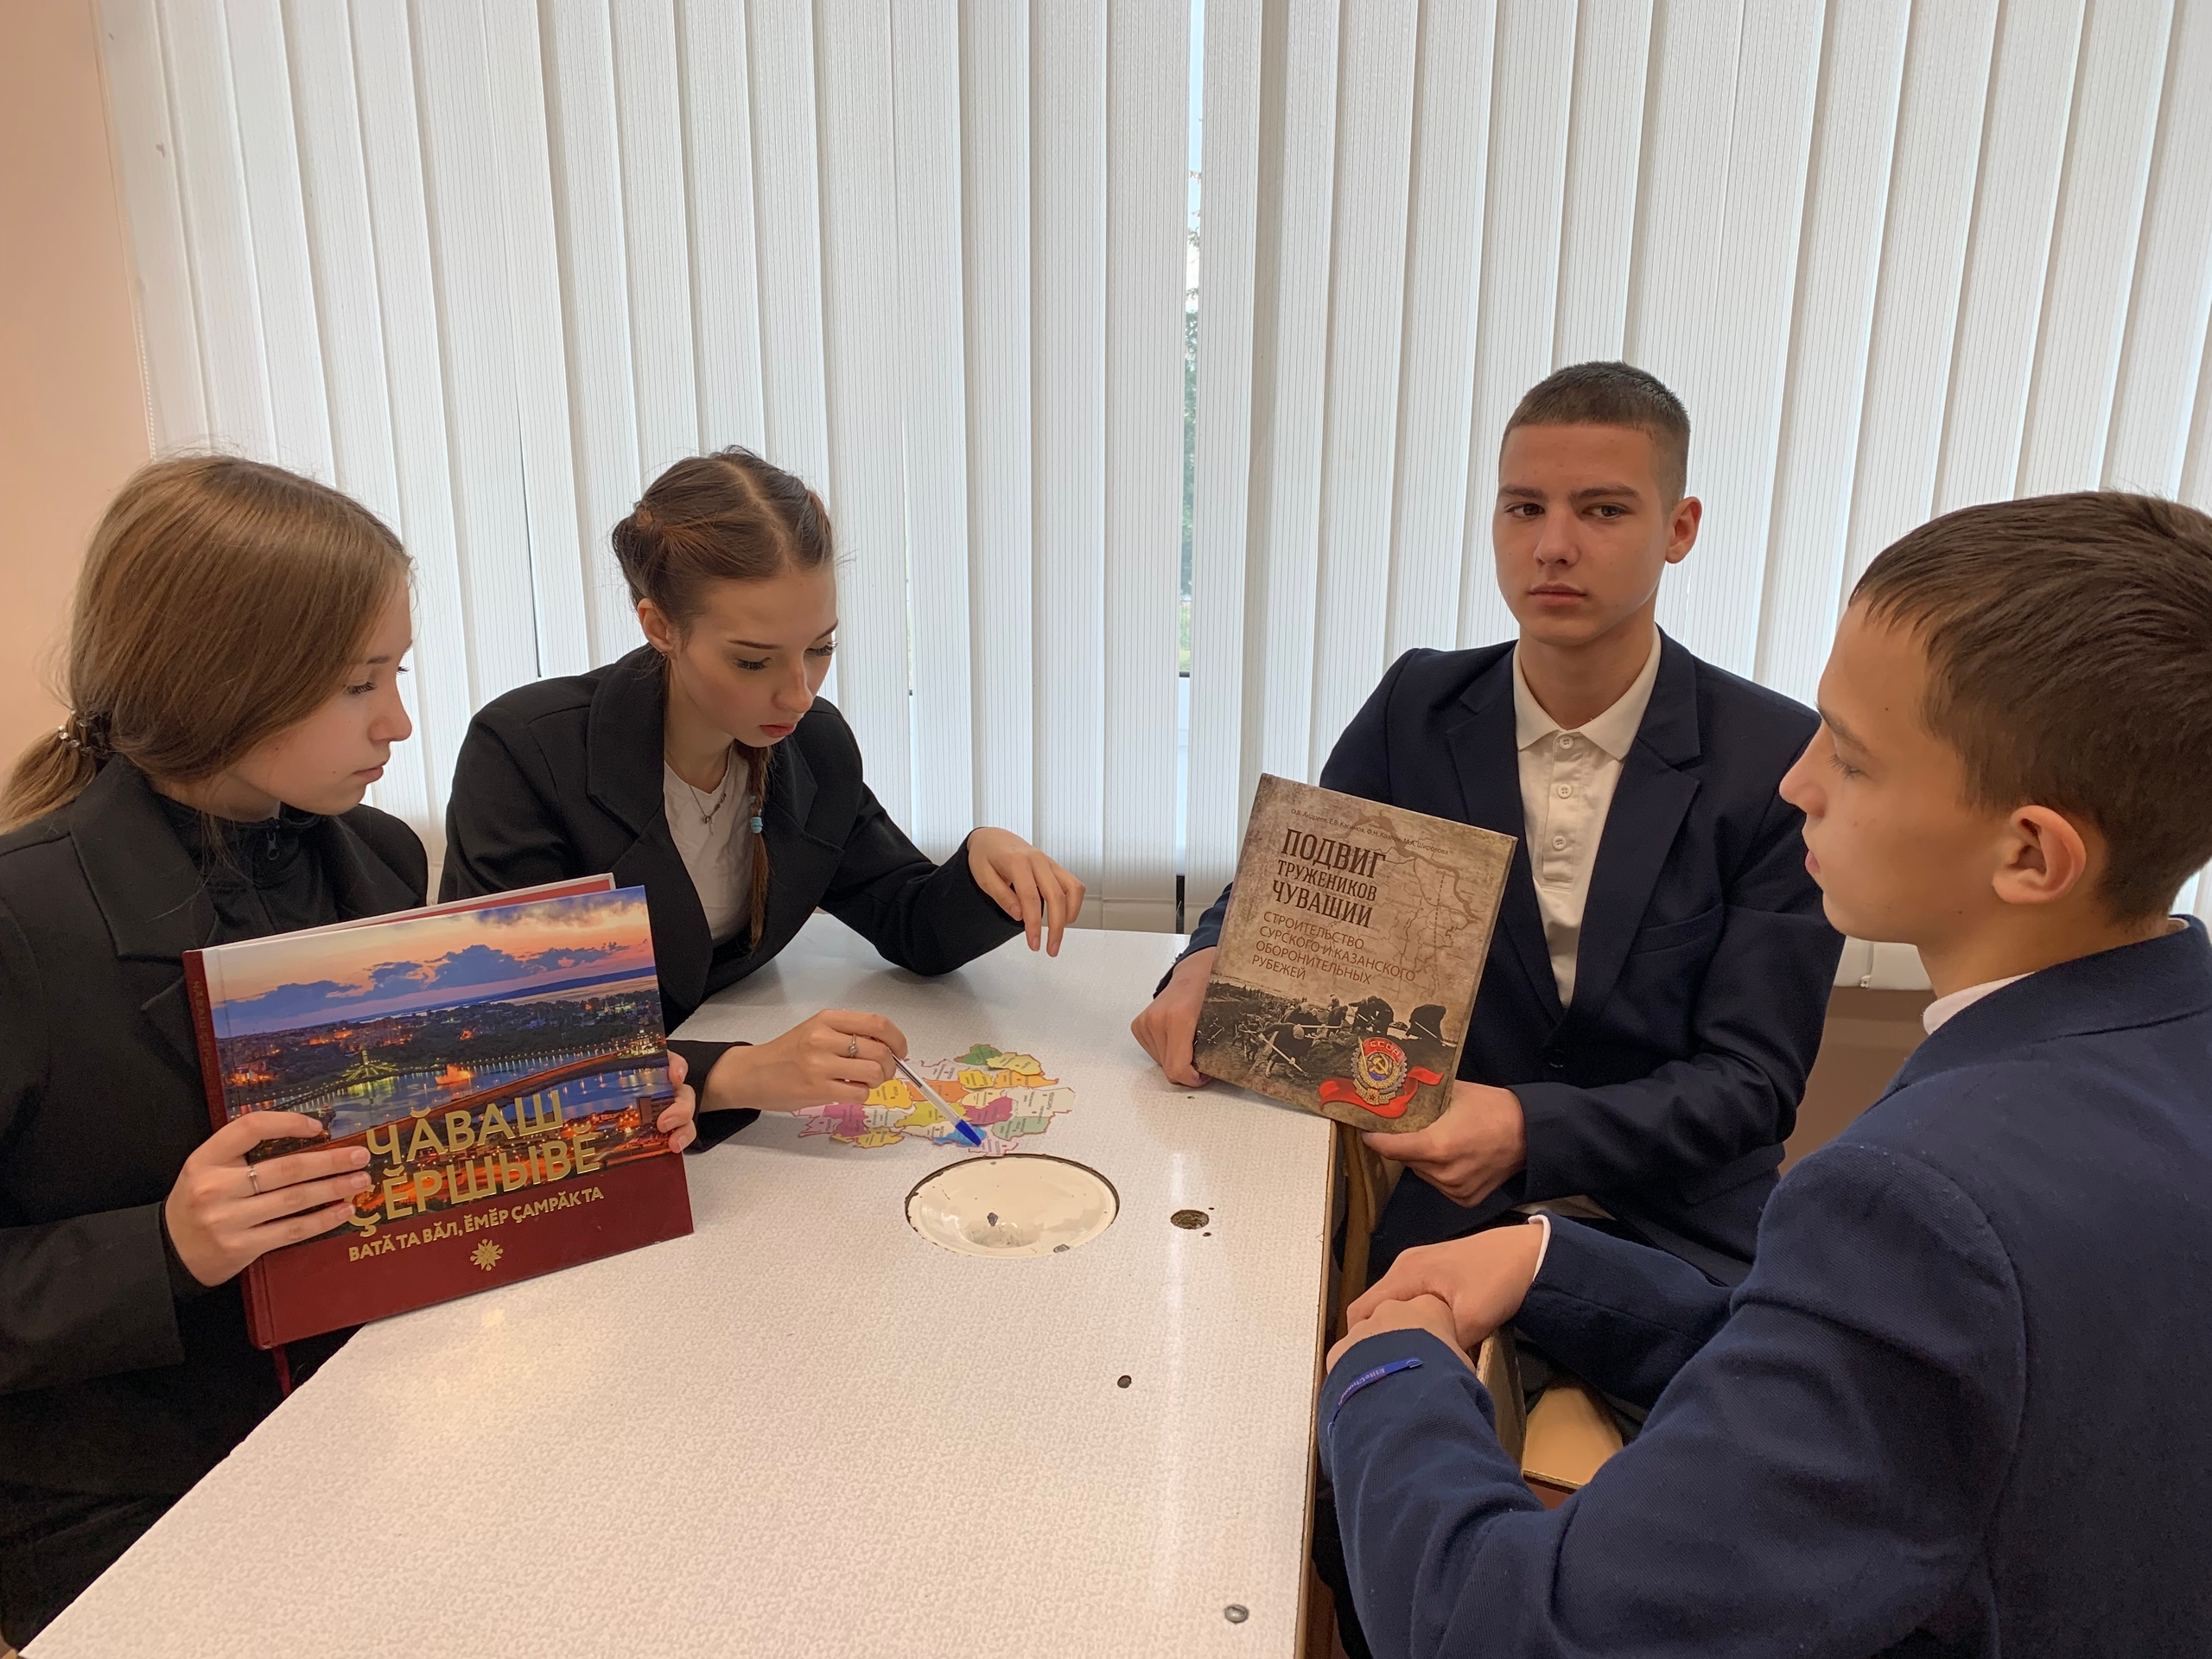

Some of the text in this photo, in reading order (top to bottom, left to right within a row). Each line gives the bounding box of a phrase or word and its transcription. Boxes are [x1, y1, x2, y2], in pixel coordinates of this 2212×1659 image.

[1281, 828, 1386, 879] ПОДВИГ
[1277, 860, 1377, 902] ТРУЖЕНИКОВ
[1272, 880, 1374, 928] ЧУВАШИИ
[1263, 911, 1364, 950] СТРОИТЕЛЬСТВО
[1252, 955, 1306, 981] РУБЕЖЕЙ
[1255, 940, 1372, 985] ОБОРОНИТЕЛЬНЫХ
[1259, 925, 1416, 982] СУРСКОГО И КАЗАНСКОГО
[1370, 1040, 1400, 1055] СССР
[396, 1230, 421, 1249] ТА
[581, 1185, 604, 1204] ТА
